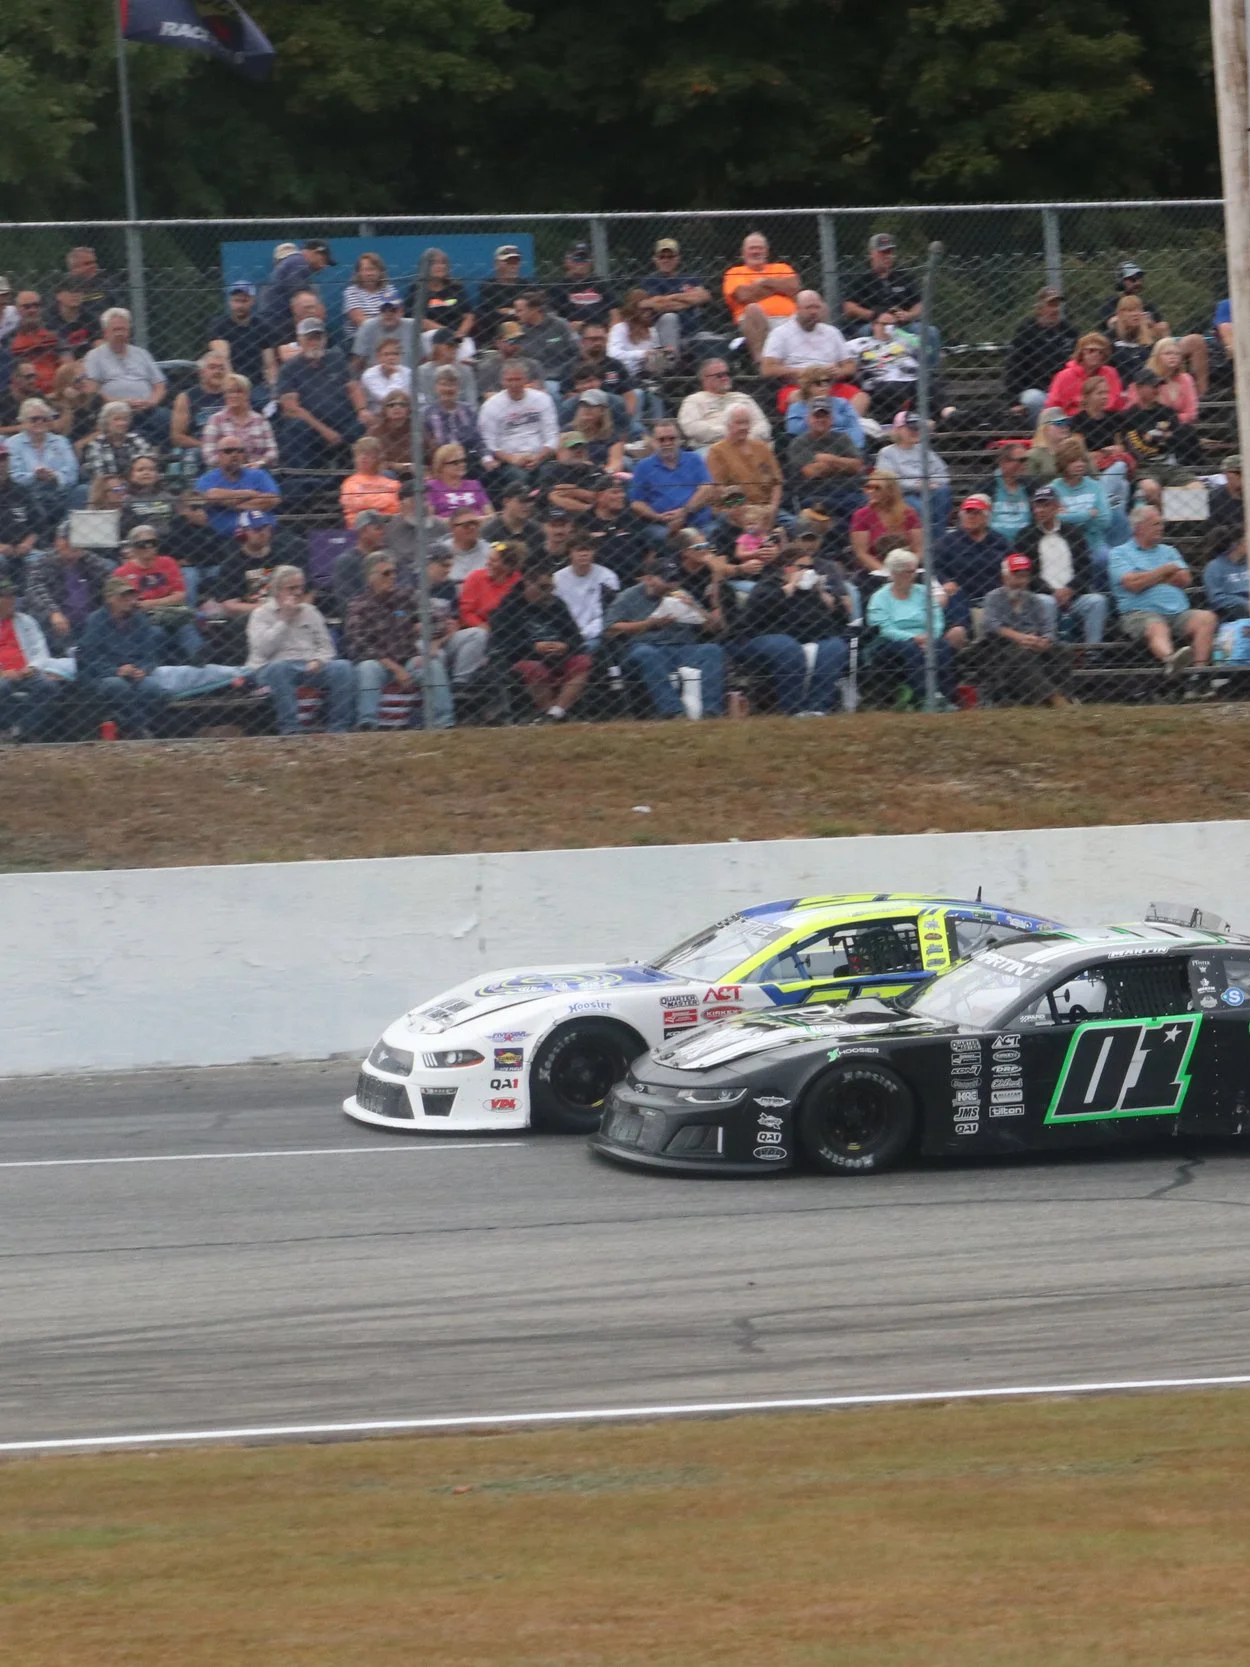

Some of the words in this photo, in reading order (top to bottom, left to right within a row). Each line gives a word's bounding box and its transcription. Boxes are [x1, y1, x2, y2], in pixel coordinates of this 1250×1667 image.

[661, 994, 697, 1004] QUARTER
[703, 985, 742, 1003] ACT
[568, 1000, 612, 1014] Hoosier
[666, 1001, 699, 1009] MASTER
[992, 1035, 1020, 1049] ACT
[490, 1078, 519, 1090] QA1
[959, 1107, 979, 1118] JMS
[992, 1107, 1022, 1115] tilton
[759, 1133, 781, 1143] QA1
